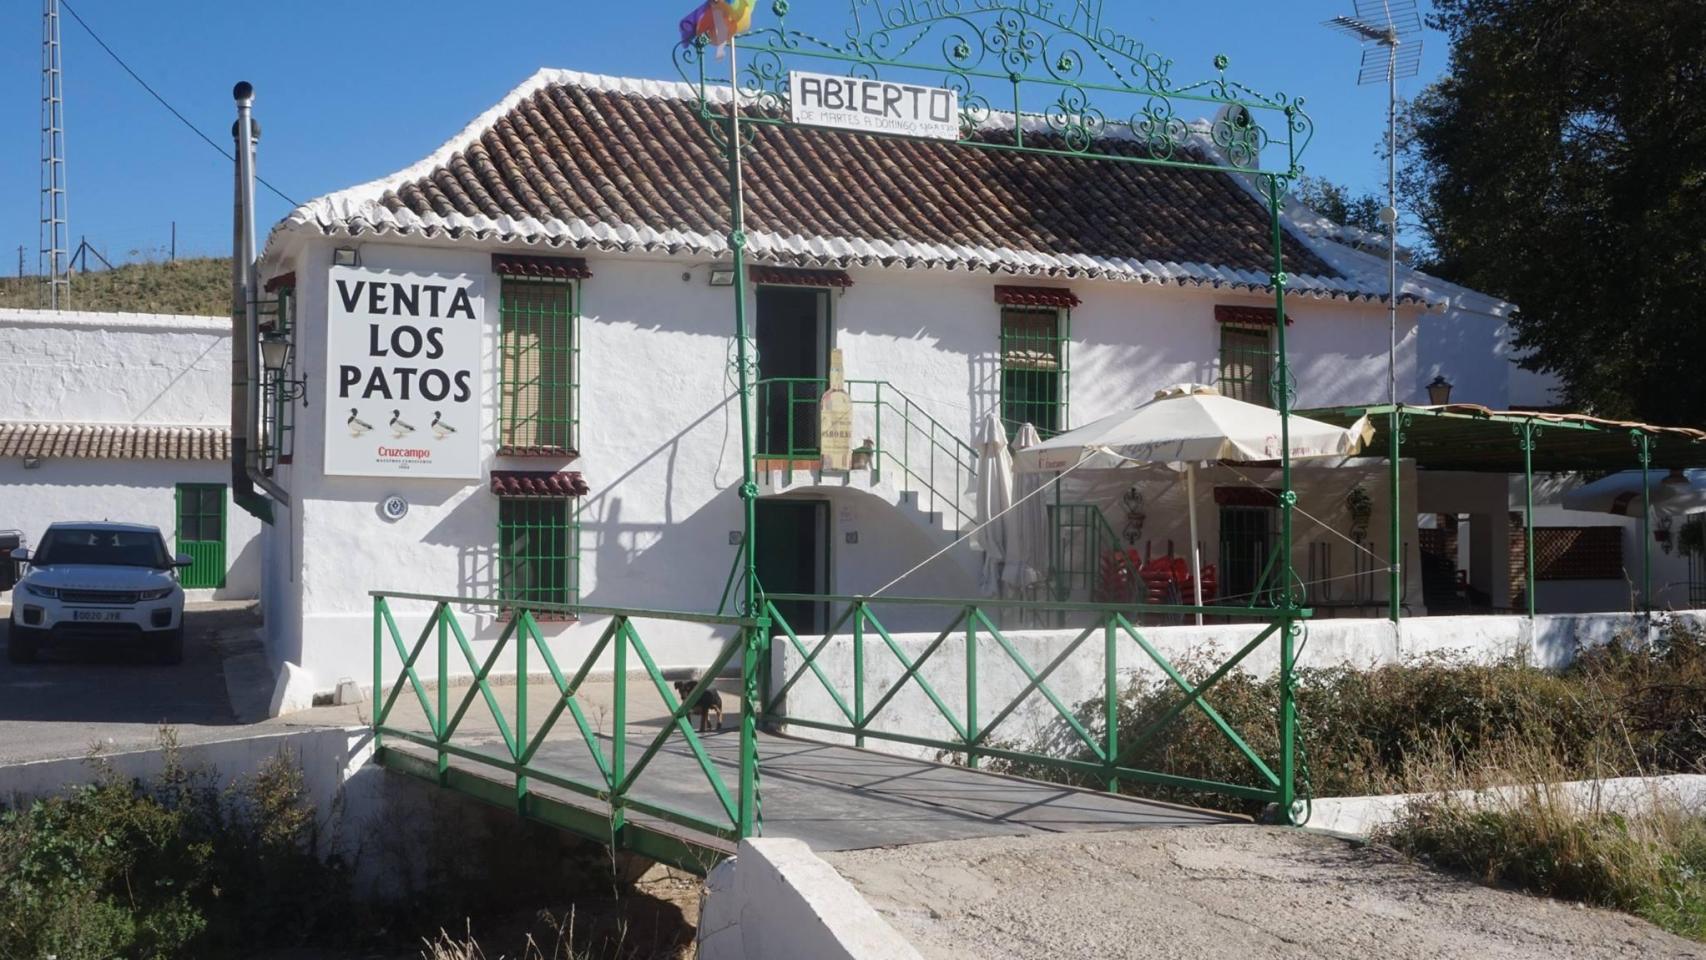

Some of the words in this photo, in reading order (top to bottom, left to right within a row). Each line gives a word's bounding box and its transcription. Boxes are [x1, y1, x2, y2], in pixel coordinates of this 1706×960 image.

[801, 78, 949, 122] ABIERTO
[800, 110, 814, 121] DE
[864, 116, 872, 126] A
[875, 117, 917, 131] DOMINGO
[335, 279, 477, 320] VENTA
[369, 323, 444, 360] LOS
[339, 364, 472, 403] PATOS
[378, 446, 430, 459] Cruzcampo
